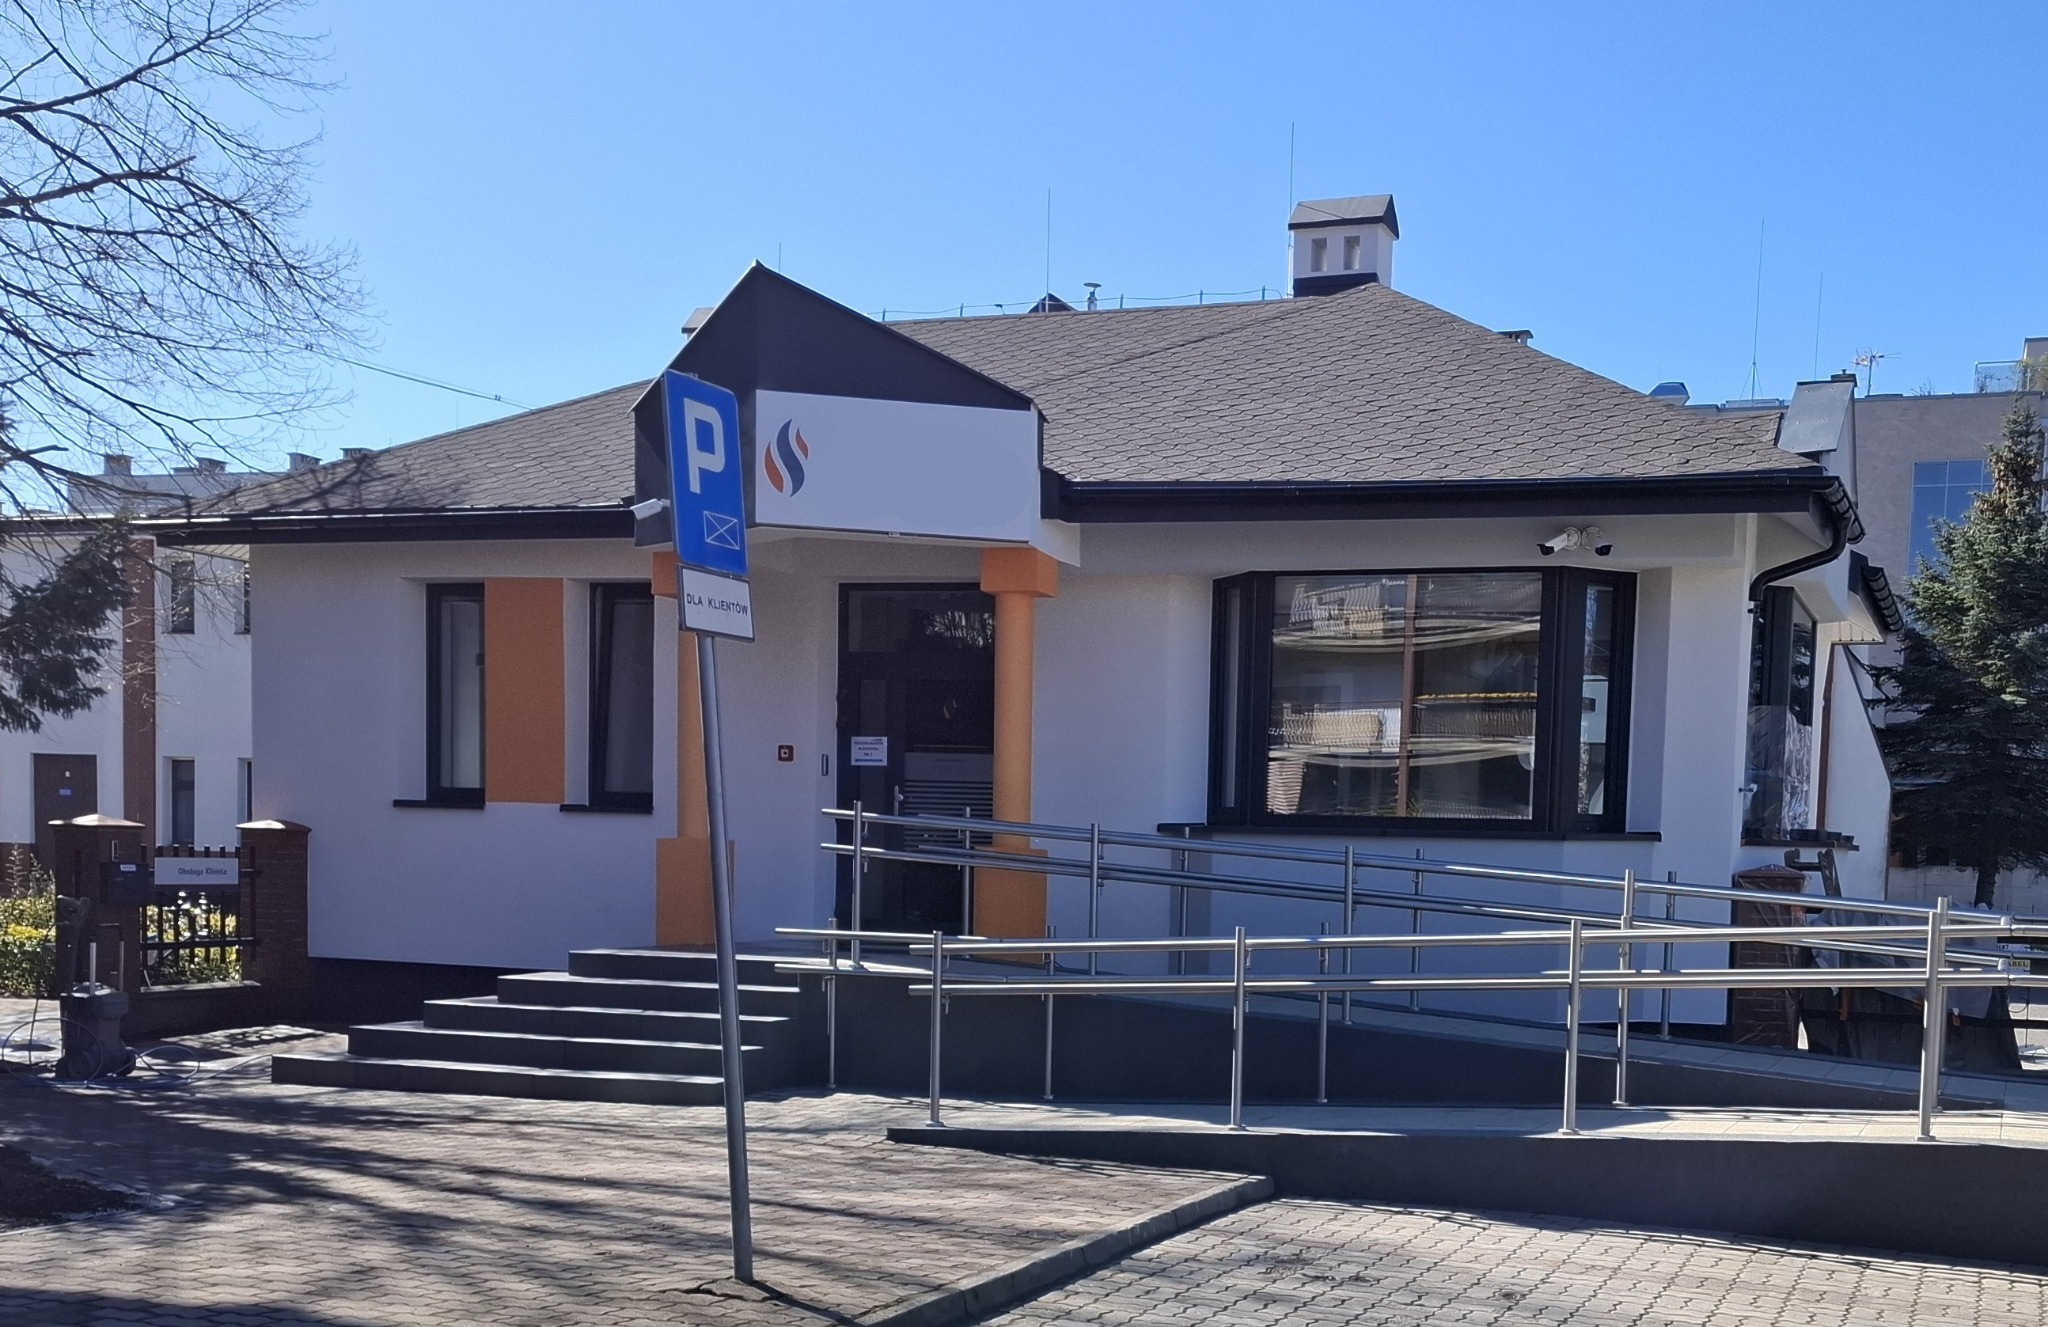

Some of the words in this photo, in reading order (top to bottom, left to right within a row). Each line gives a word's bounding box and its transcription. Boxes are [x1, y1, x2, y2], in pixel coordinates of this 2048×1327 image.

[684, 398, 725, 494] P
[687, 593, 704, 606] DLA
[708, 597, 748, 616] KLIENTÓW
[205, 867, 227, 875] Klienta
